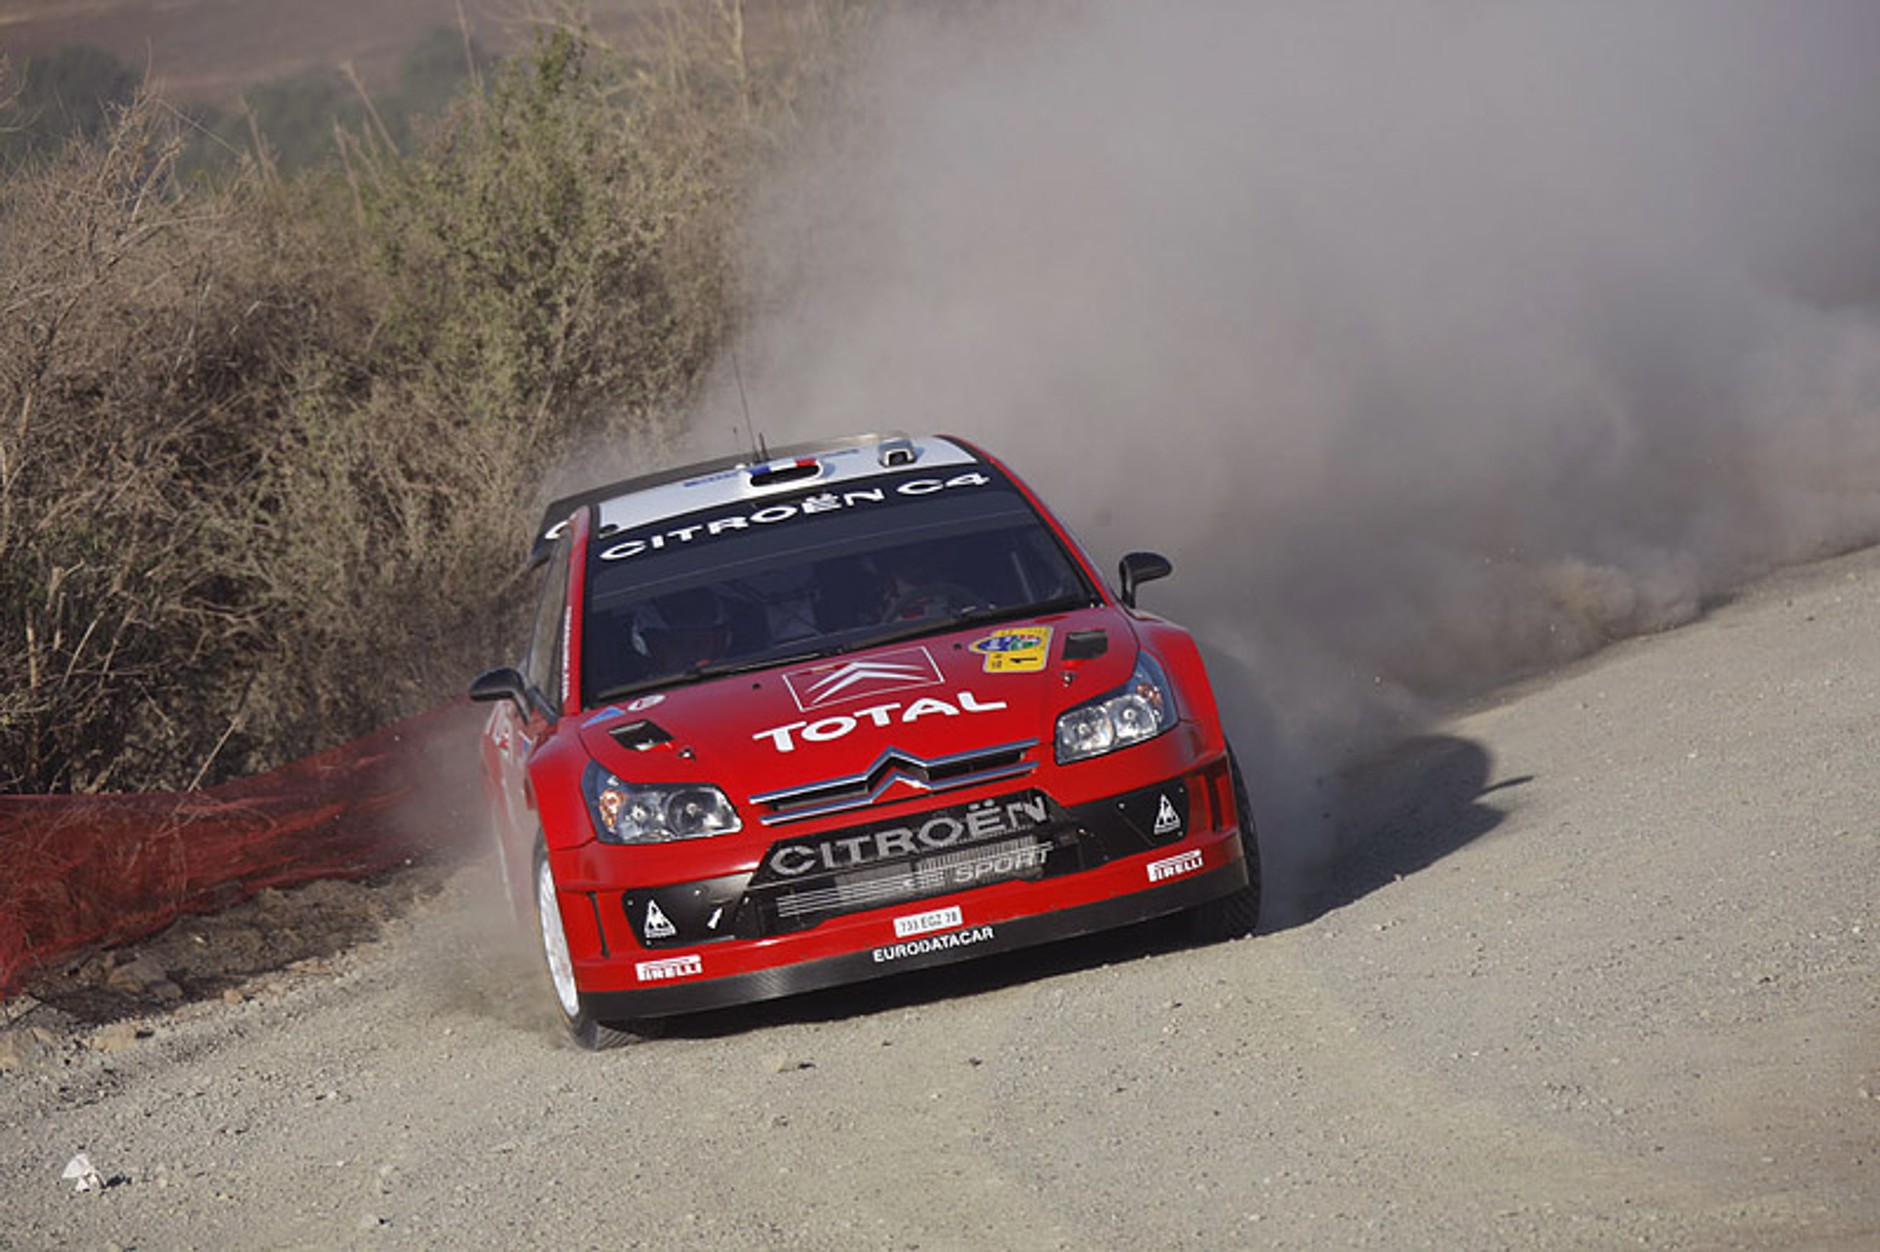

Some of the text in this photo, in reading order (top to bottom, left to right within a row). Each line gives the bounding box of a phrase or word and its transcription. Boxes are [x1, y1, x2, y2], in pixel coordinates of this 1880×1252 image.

[600, 488, 885, 561] CITROËN
[897, 472, 990, 495] C4
[752, 690, 1008, 752] TOTAL
[769, 795, 1049, 876] CITROËN
[954, 843, 1053, 883] SPORT
[1146, 848, 1204, 882] PIRELLI
[872, 925, 995, 963] EURODATACAR
[634, 953, 703, 982] PIRELLI
